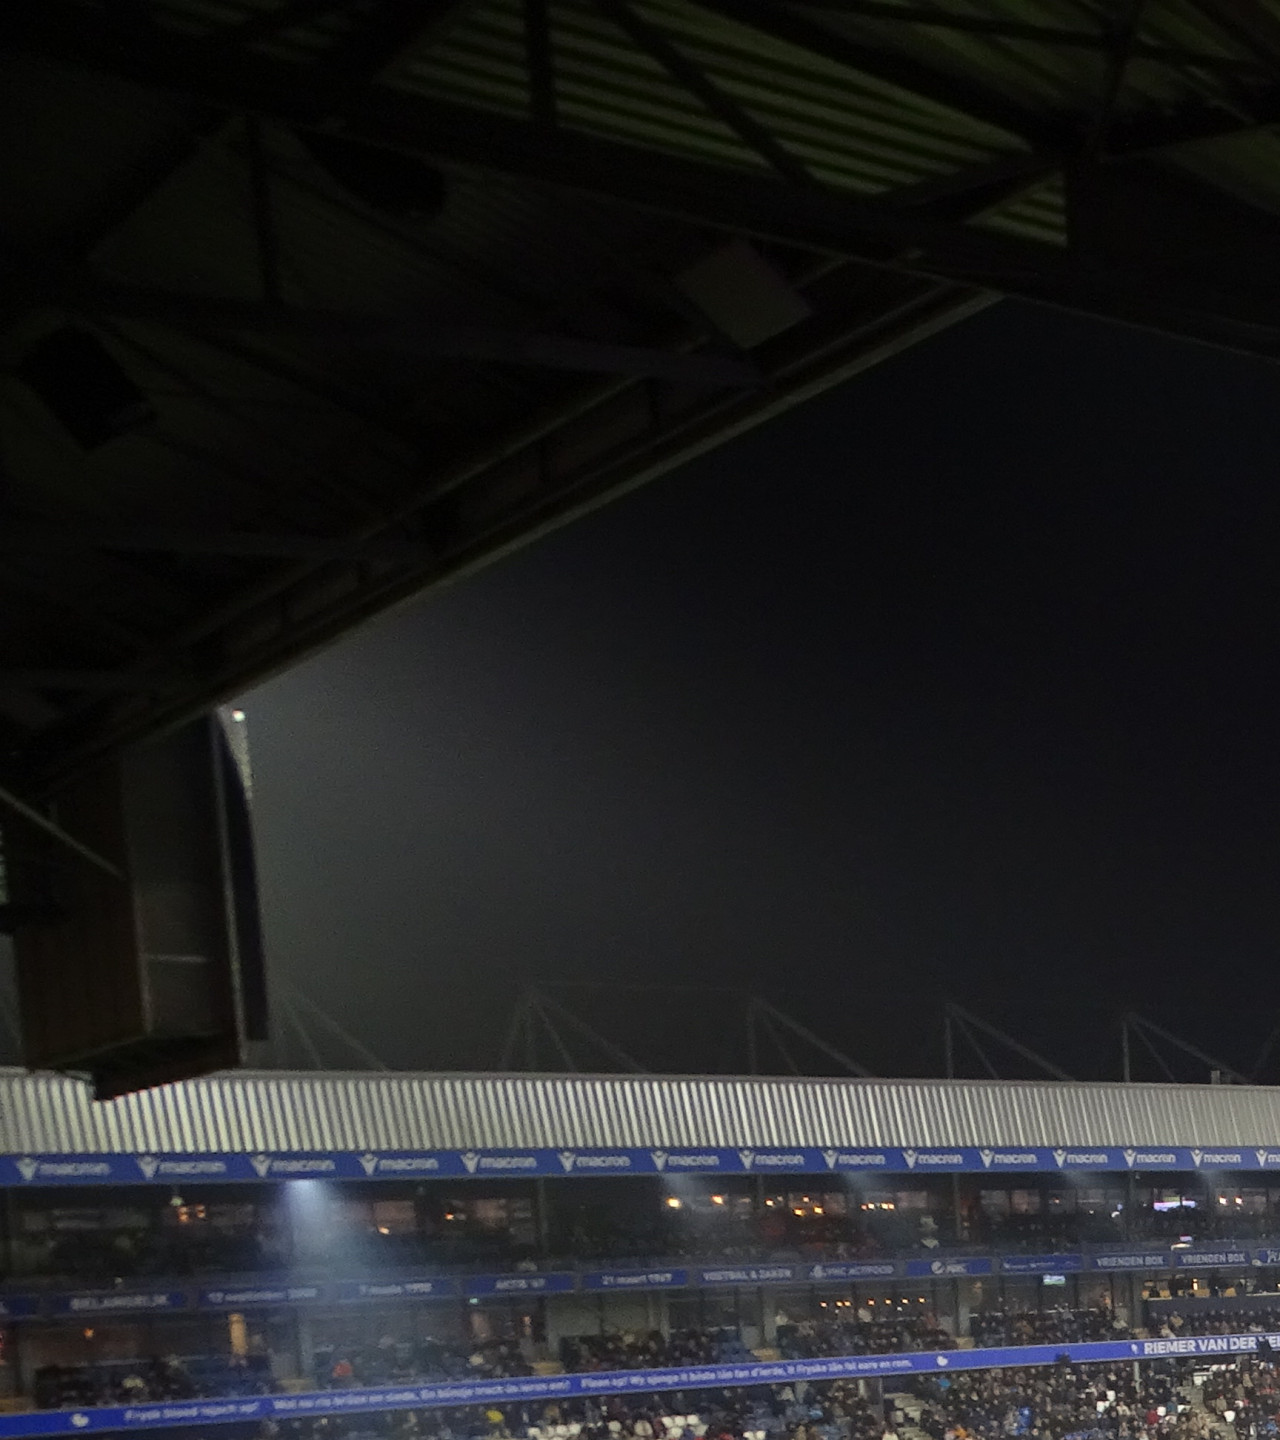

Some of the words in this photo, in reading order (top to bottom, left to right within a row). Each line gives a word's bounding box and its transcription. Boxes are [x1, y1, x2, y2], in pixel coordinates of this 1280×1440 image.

[755, 1154, 805, 1166] macron
[838, 1153, 886, 1166] macron
[916, 1153, 963, 1165] macron
[993, 1153, 1037, 1165] macron
[1066, 1152, 1108, 1164] macron
[1135, 1152, 1177, 1164] macron
[1203, 1152, 1242, 1164] macron
[1096, 1256, 1140, 1267] VRIENDEN
[1141, 1256, 1164, 1267] BOX
[1181, 1253, 1224, 1265] VRIENDEN
[1225, 1253, 1245, 1264] BOX
[1144, 1339, 1196, 1355] RIEMER
[1199, 1337, 1228, 1353] VAN
[1229, 1336, 1256, 1351] DER
